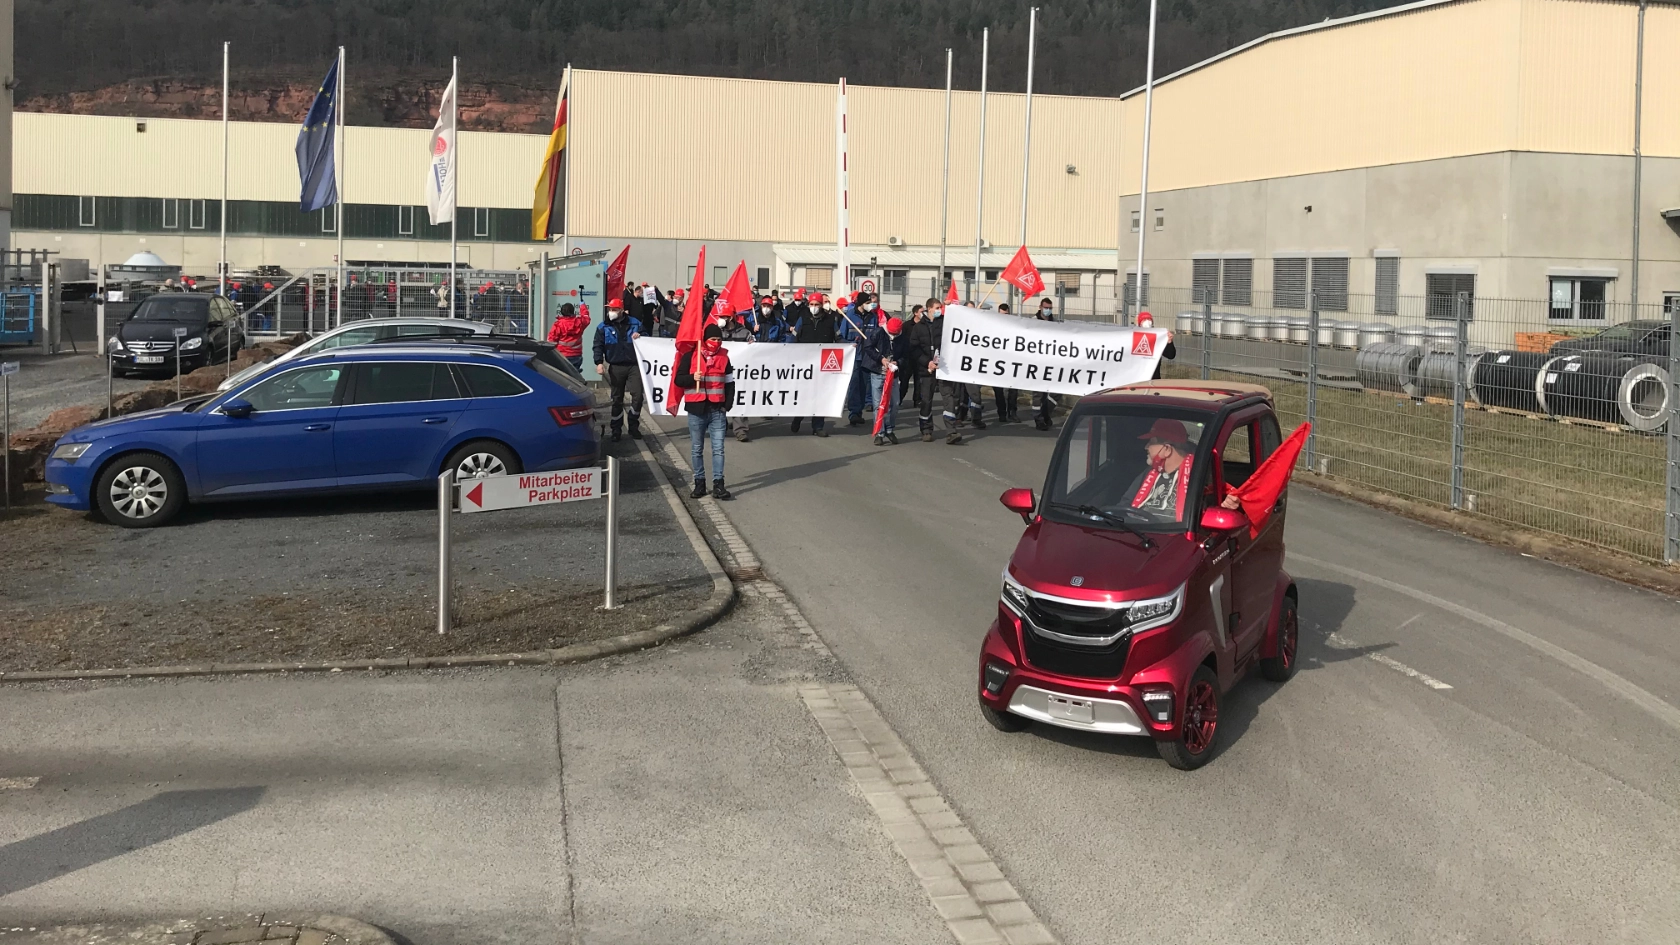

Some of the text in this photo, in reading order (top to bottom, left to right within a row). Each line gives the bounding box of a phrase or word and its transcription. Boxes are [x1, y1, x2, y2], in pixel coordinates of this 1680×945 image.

[951, 327, 1125, 362] Dieser Betrieb wird
[776, 363, 814, 380] wird
[960, 355, 1107, 387] BESTREIKT!
[519, 472, 593, 489] Mitarbeiter
[529, 486, 593, 502] Parkplatz
